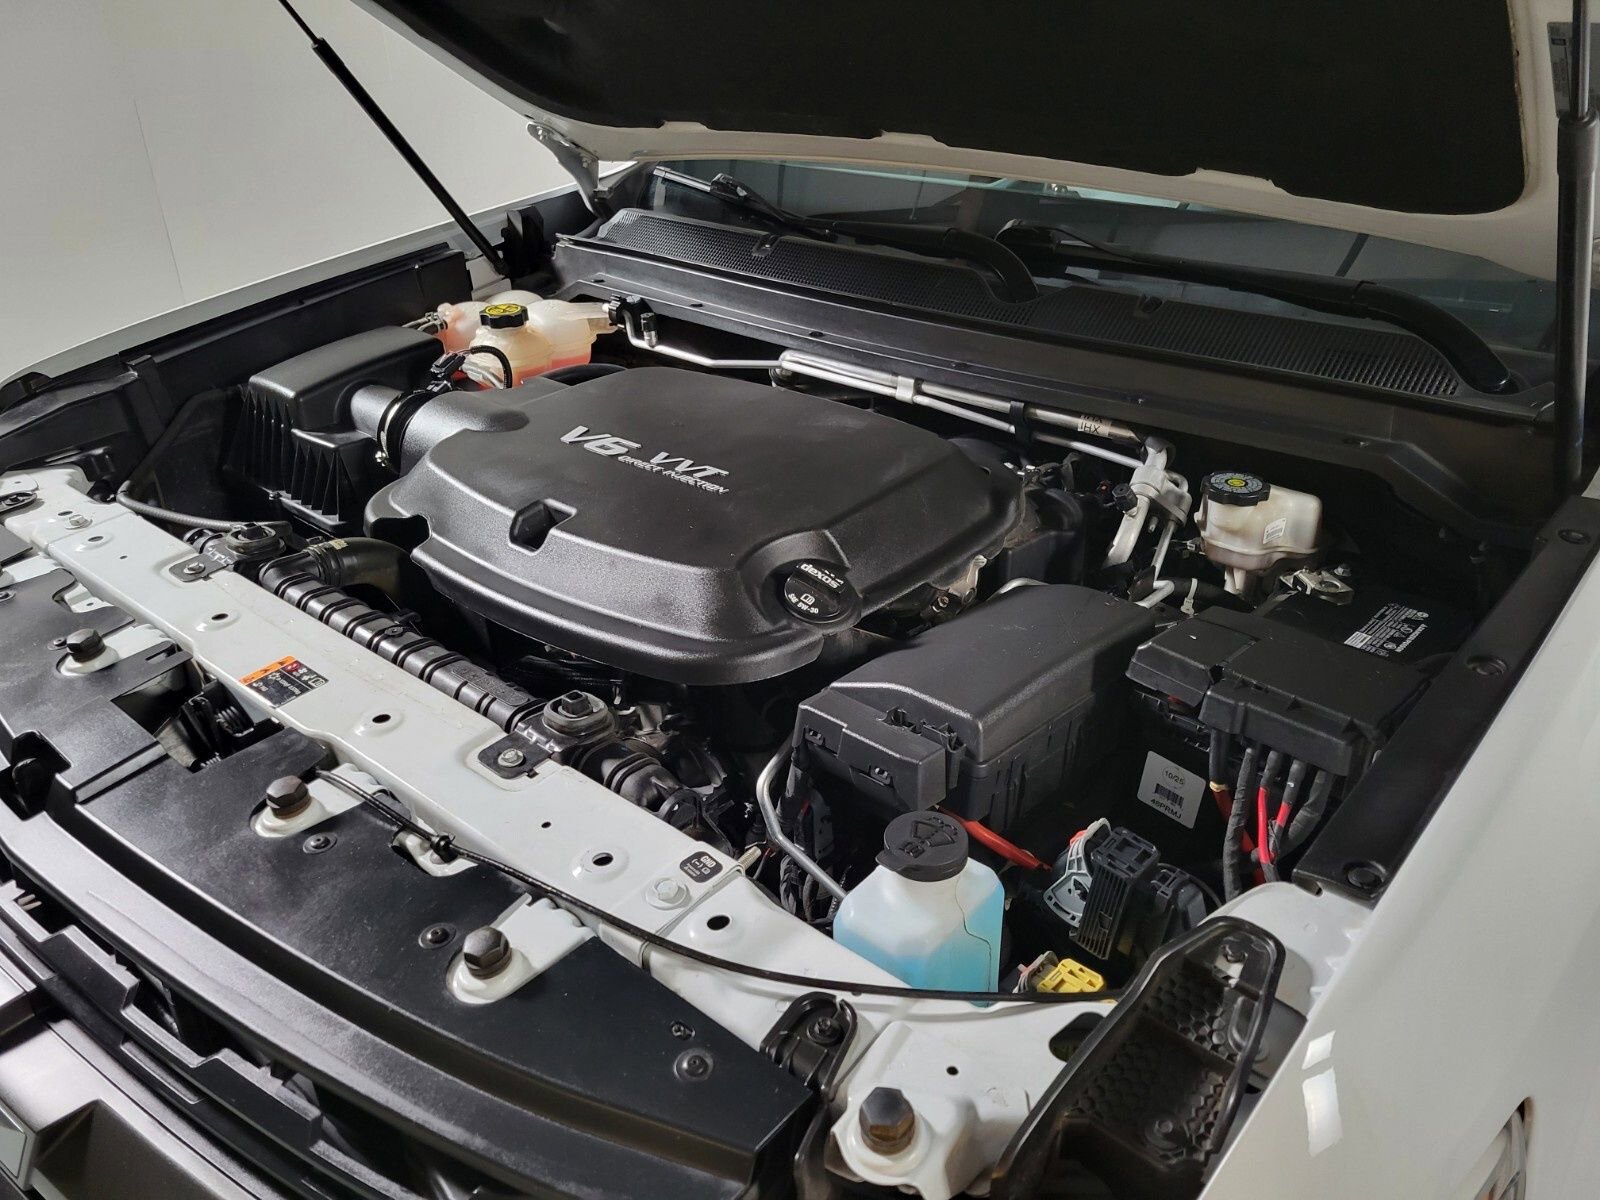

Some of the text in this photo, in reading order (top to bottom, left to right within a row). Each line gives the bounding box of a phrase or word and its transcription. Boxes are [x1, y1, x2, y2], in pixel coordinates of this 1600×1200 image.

[560, 425, 730, 478] V6 VVT
[618, 455, 730, 495] DIRECT INJECTION
[800, 563, 840, 589] dexos
[797, 601, 819, 614] 5W-30
[700, 855, 717, 868] GND
